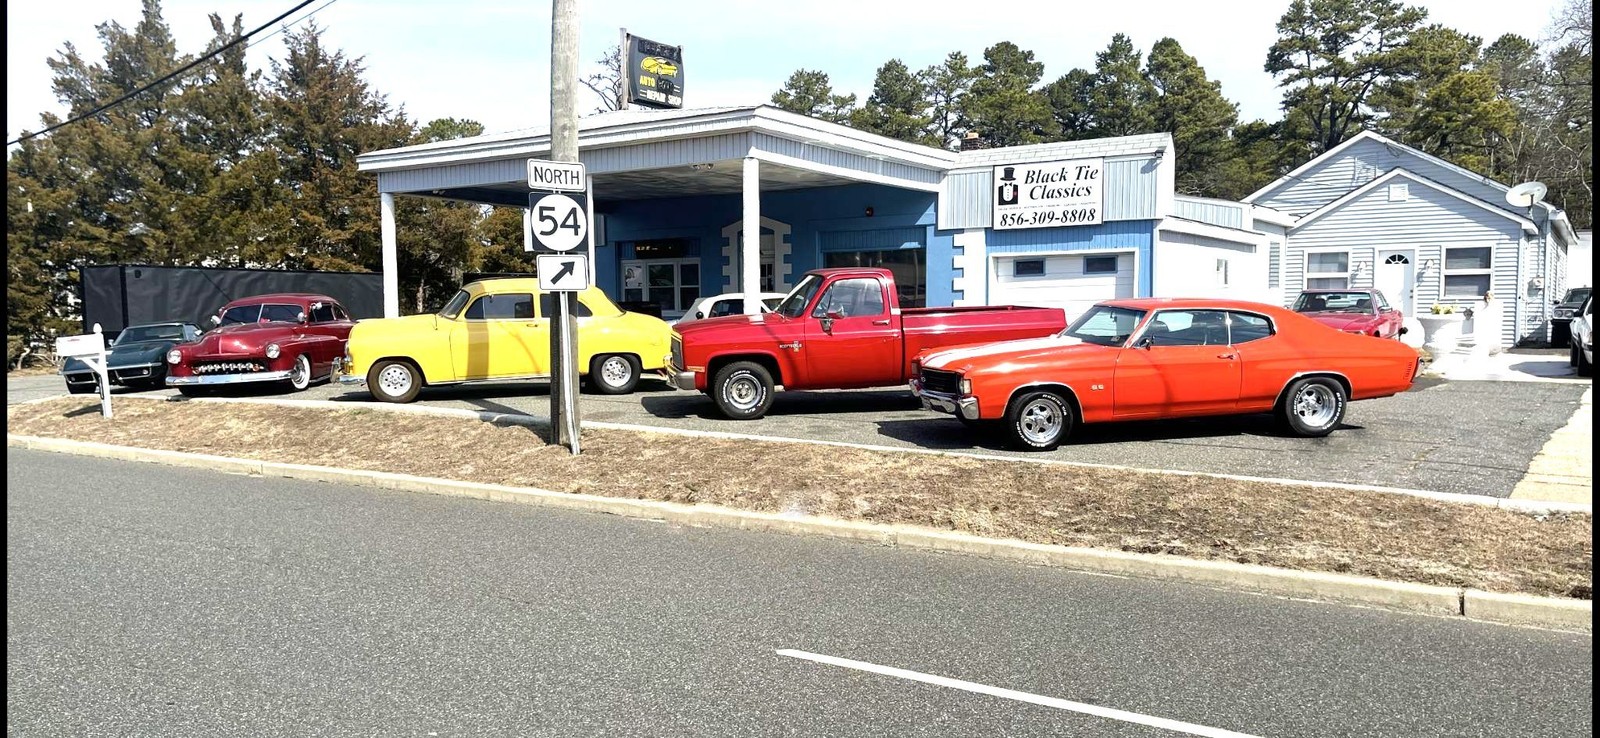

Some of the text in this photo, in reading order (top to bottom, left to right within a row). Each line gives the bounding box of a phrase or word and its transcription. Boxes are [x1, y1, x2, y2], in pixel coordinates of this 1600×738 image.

[640, 75, 656, 87] AUTO
[534, 166, 580, 186] NORTH
[1024, 165, 1099, 185] Black Tie
[1029, 183, 1093, 200] Classics
[538, 206, 581, 237] 54
[1000, 208, 1097, 227] 856-309-8808
